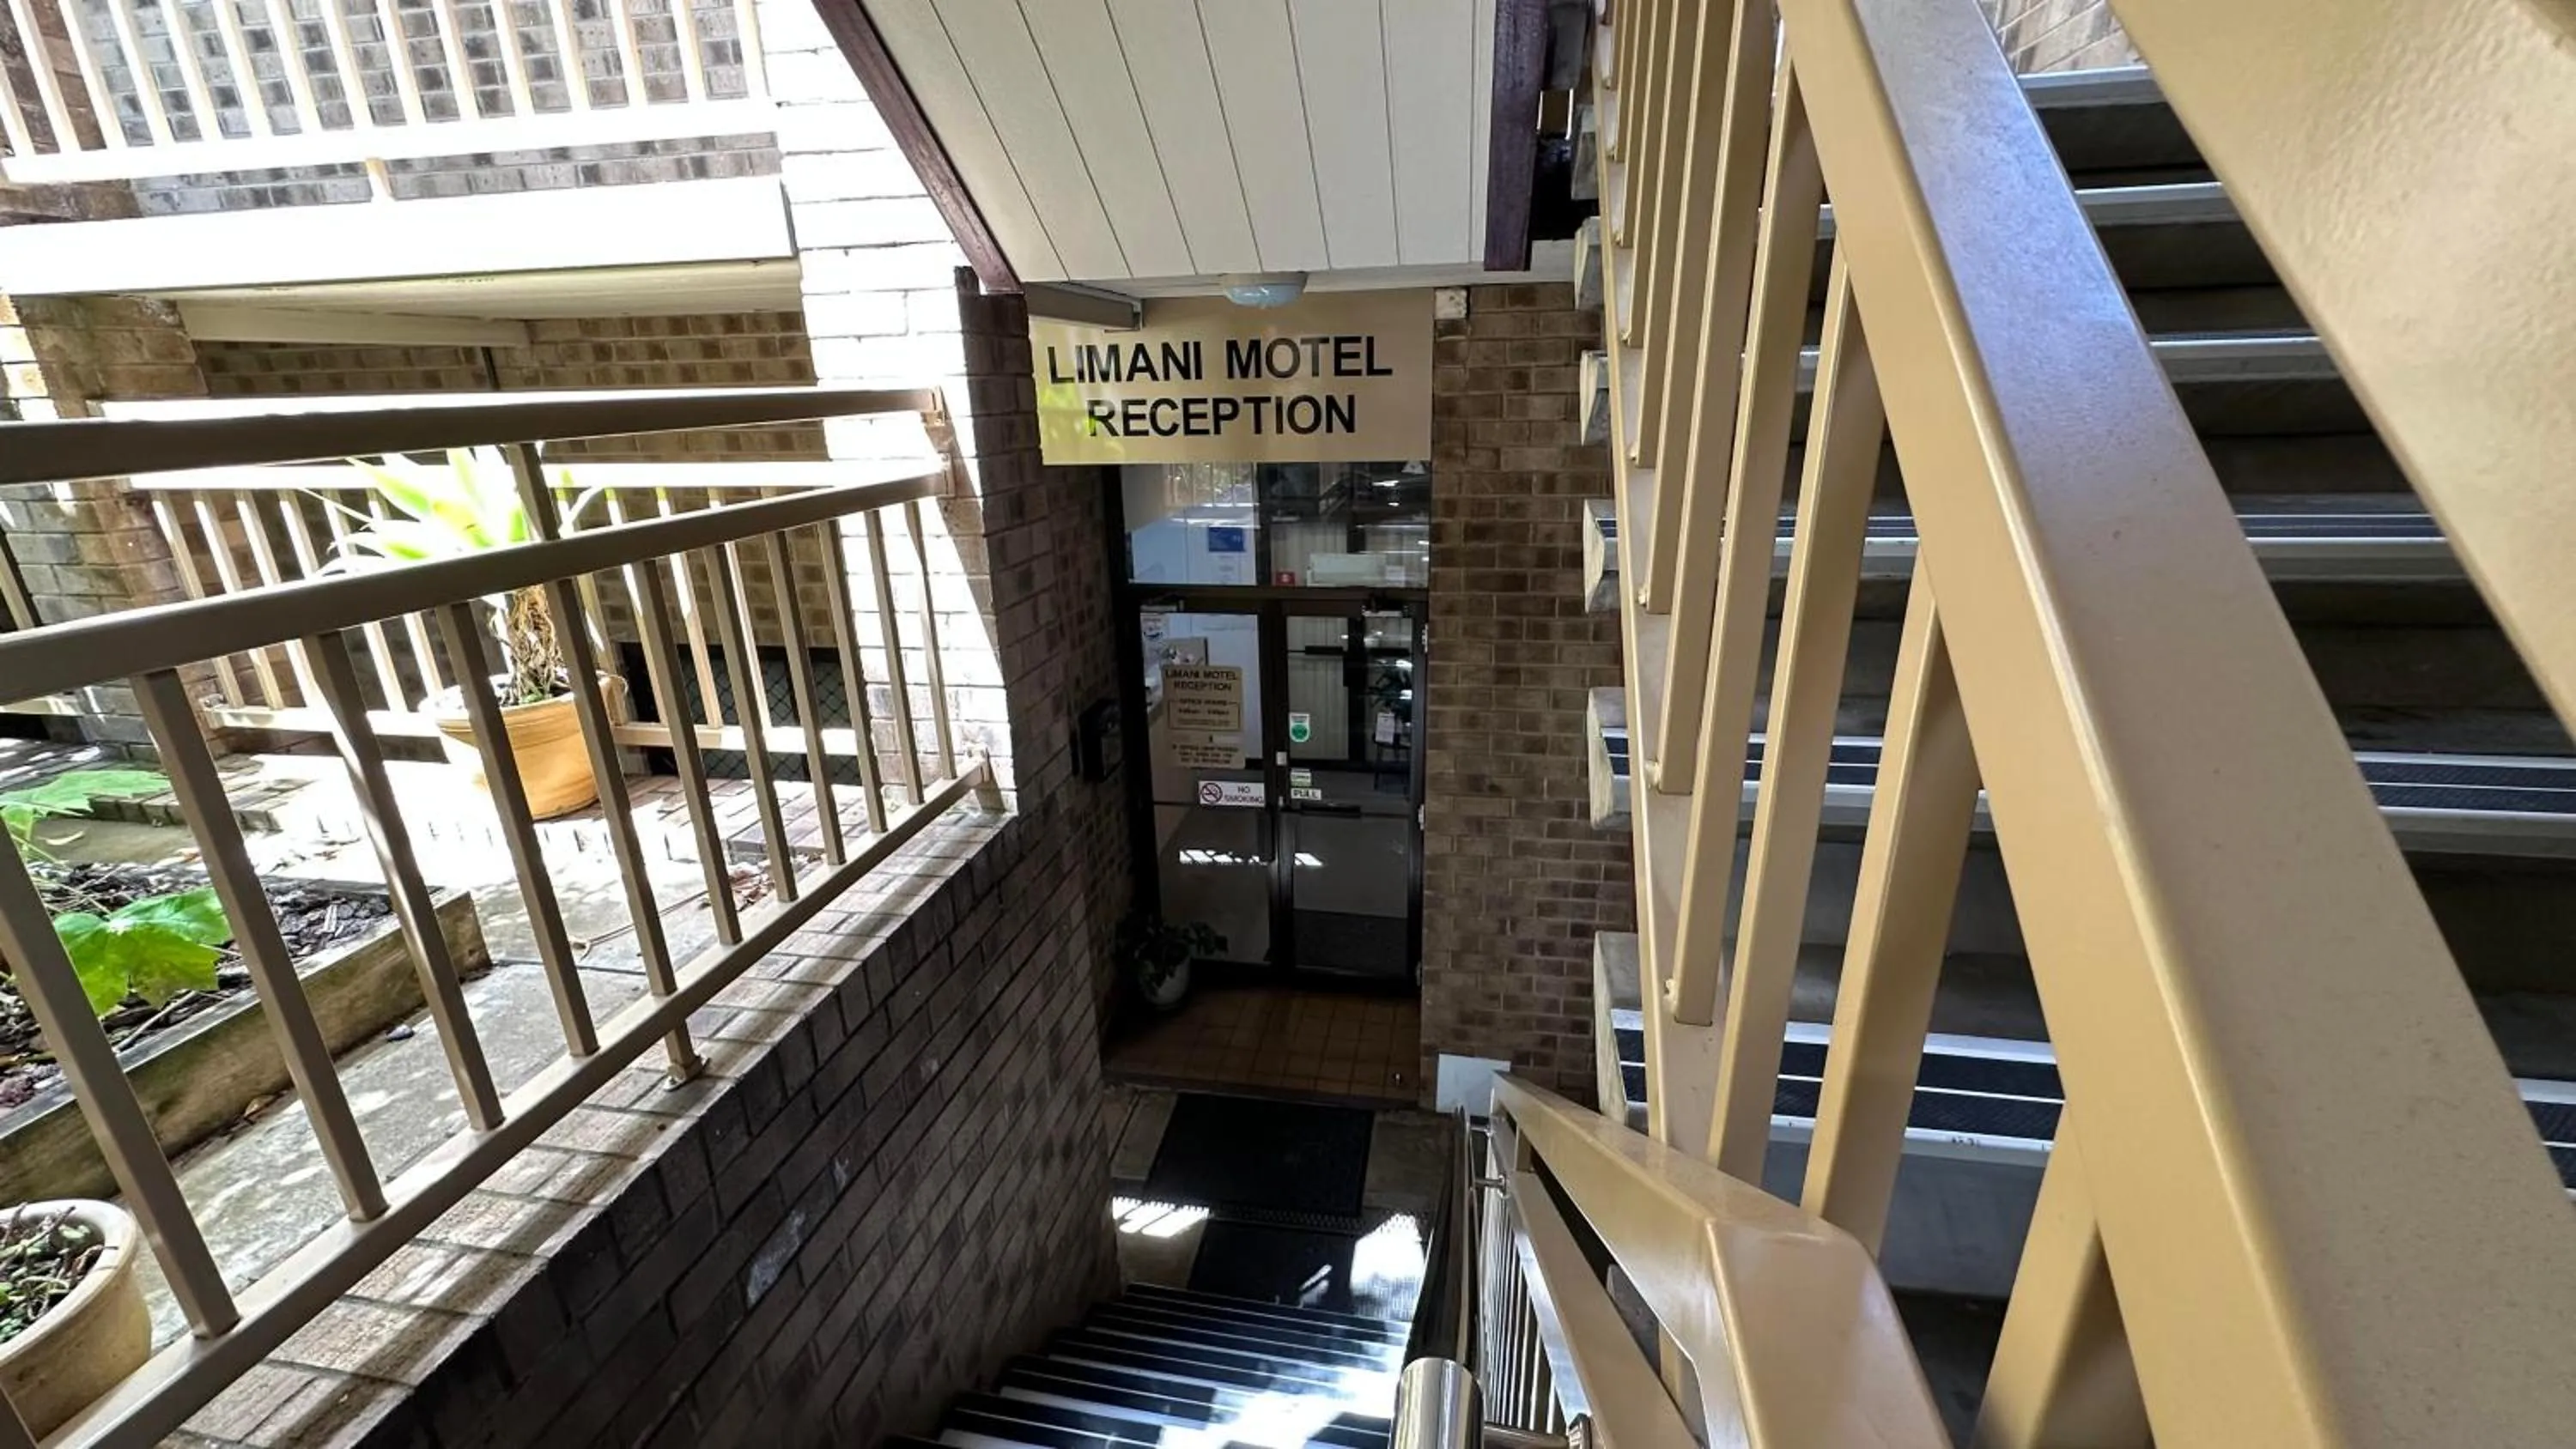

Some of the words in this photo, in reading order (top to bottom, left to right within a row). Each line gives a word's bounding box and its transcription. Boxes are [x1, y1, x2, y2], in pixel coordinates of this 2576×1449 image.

[1047, 342, 1202, 384] LIMANI
[1225, 336, 1393, 379] MOTEL
[1087, 395, 1356, 437] RECEPTION
[1204, 670, 1237, 681] MOTEL
[1174, 682, 1232, 691] RECEPTION
[1237, 785, 1251, 794] NO
[1293, 789, 1318, 799] PULL
[1224, 795, 1264, 804] SMOKING
